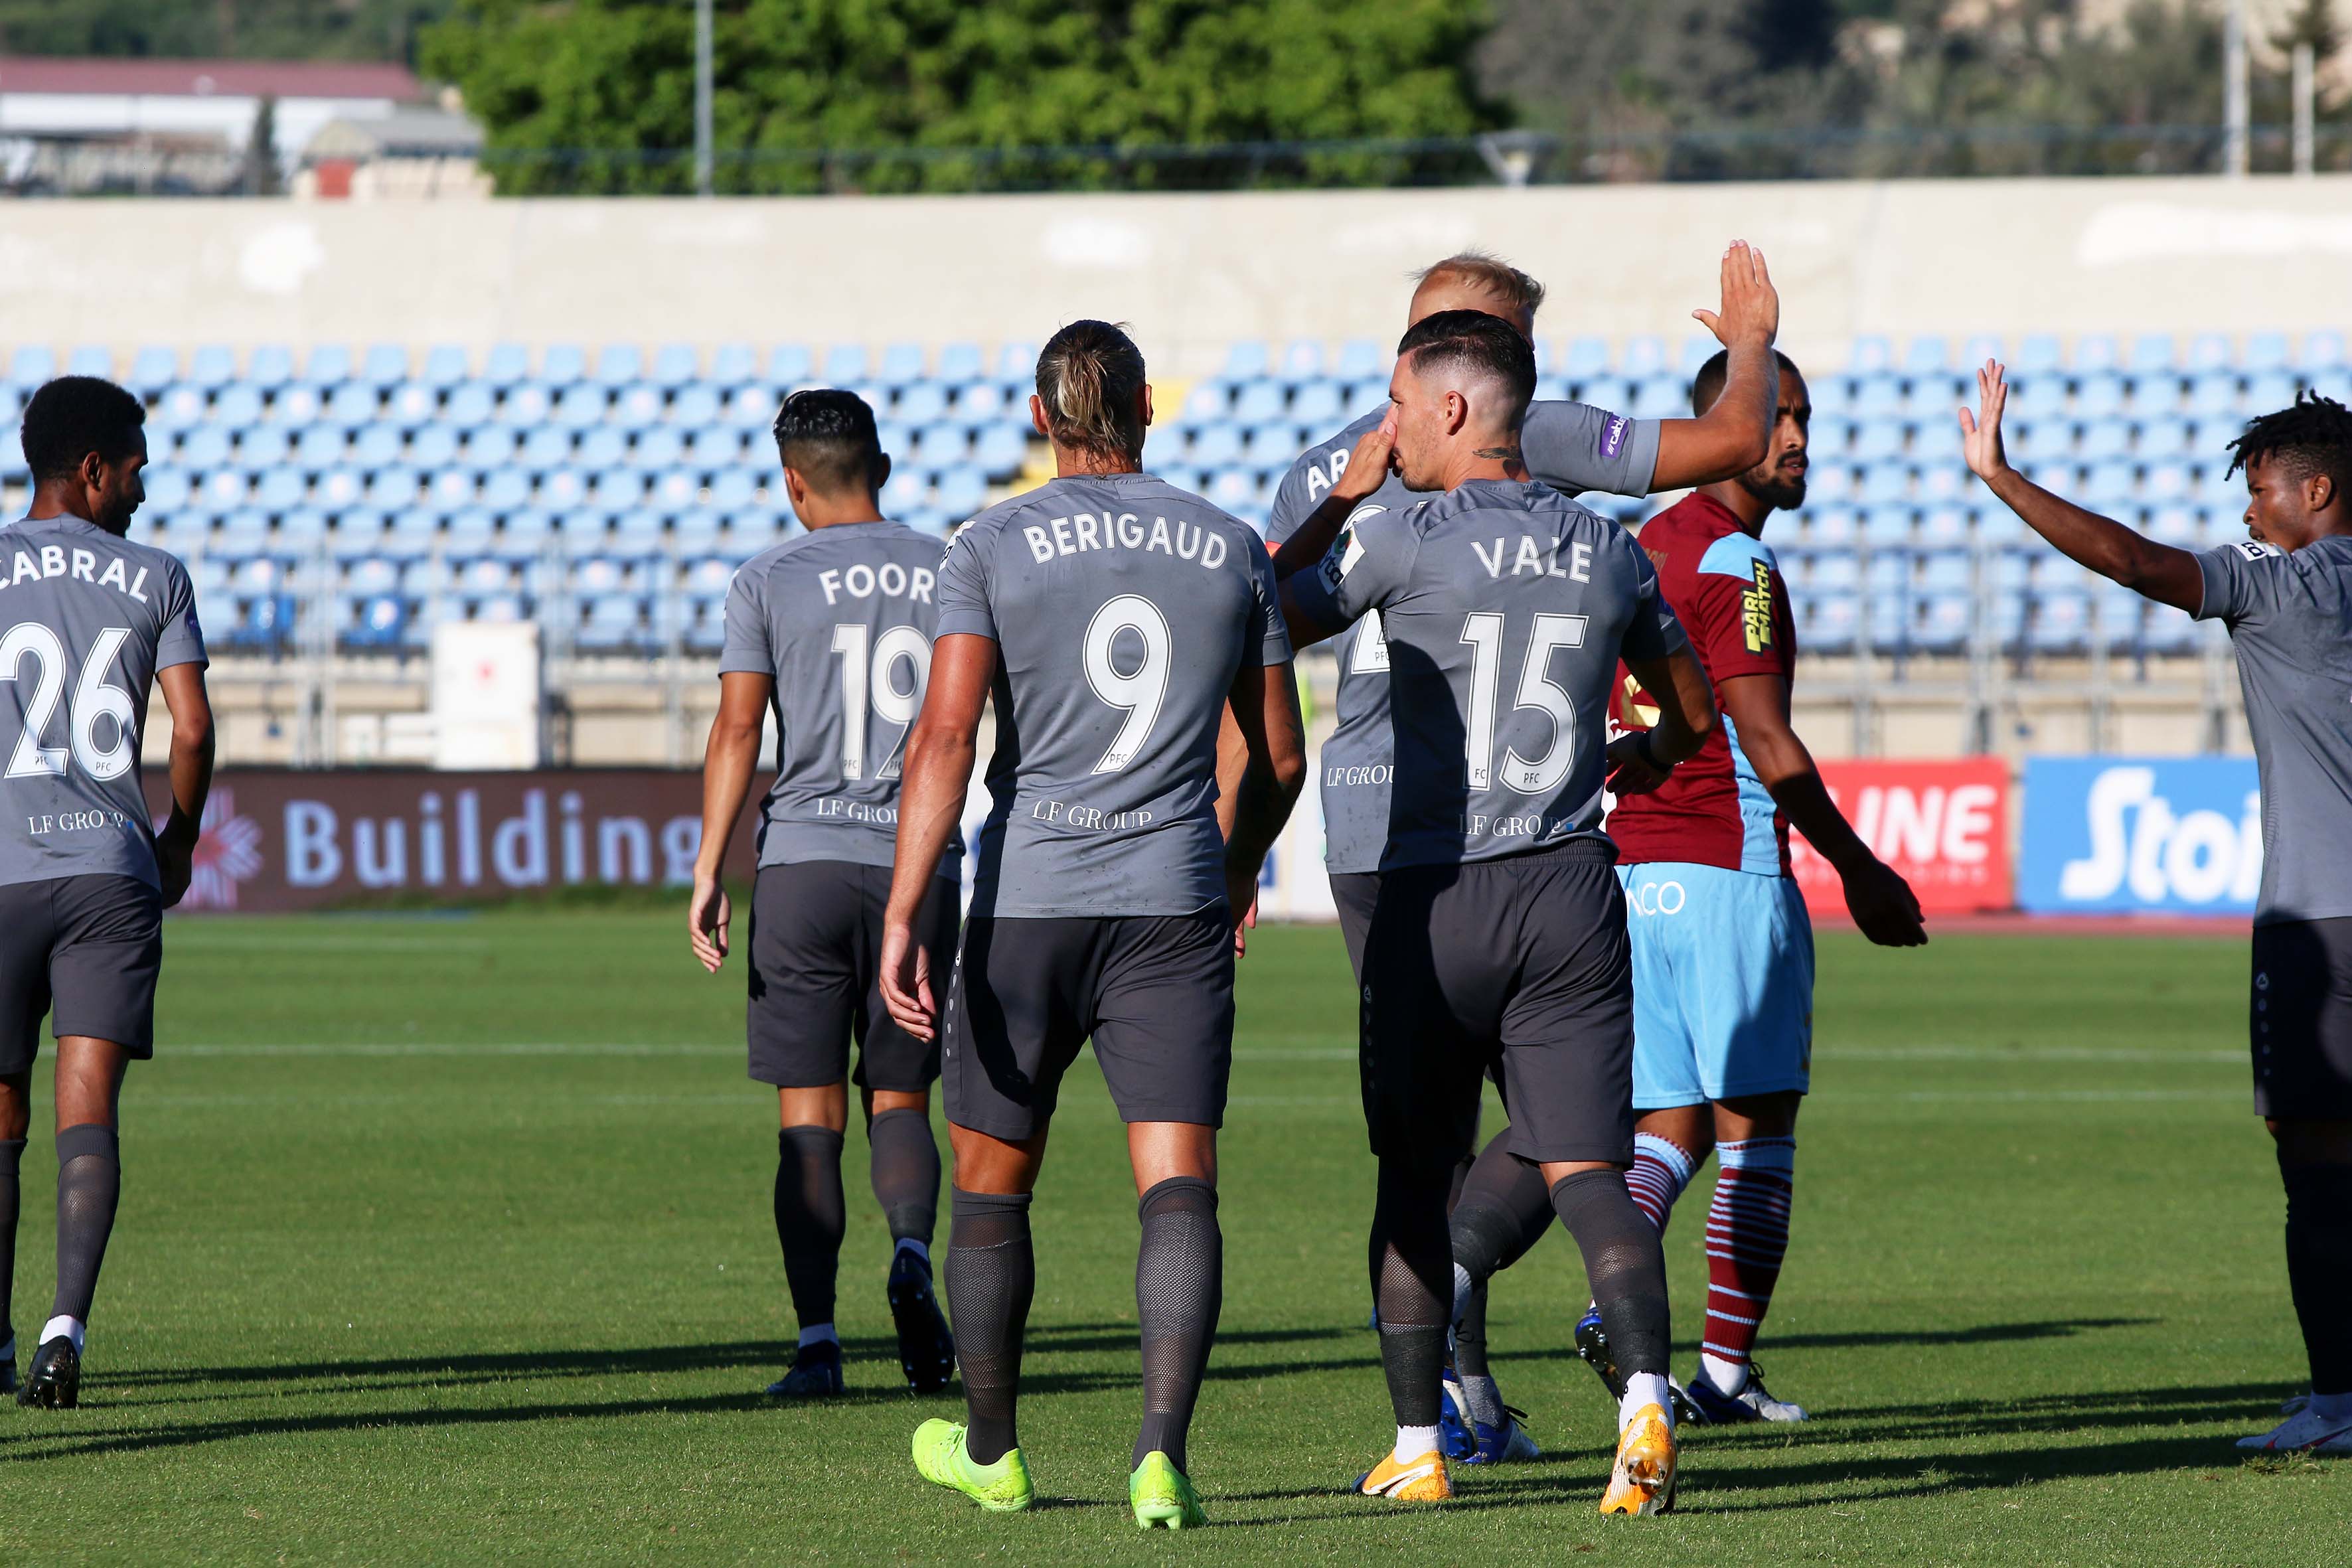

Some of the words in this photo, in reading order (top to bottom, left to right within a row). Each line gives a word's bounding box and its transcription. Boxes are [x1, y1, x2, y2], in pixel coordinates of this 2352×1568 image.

[1023, 511, 1227, 570] BERIGAUD
[1470, 534, 1592, 584] VALE
[818, 562, 935, 605] FOOR
[1755, 562, 1771, 645] MATCH
[1742, 589, 1761, 652] PARI
[0, 621, 137, 781] 26
[830, 623, 934, 781] 19
[1082, 593, 1172, 775] 9
[1459, 611, 1590, 795] 15
[35, 755, 48, 766] PFC
[95, 761, 111, 771] PFC
[1109, 753, 1127, 763] PFC
[1326, 767, 1346, 787] LF
[1524, 772, 1540, 783] PFC
[27, 815, 53, 834] LF
[817, 798, 843, 816] LF
[1032, 801, 1063, 823] LF
[1067, 805, 1152, 830] GROUP
[1826, 783, 1998, 862] INE
[283, 788, 705, 888] Building
